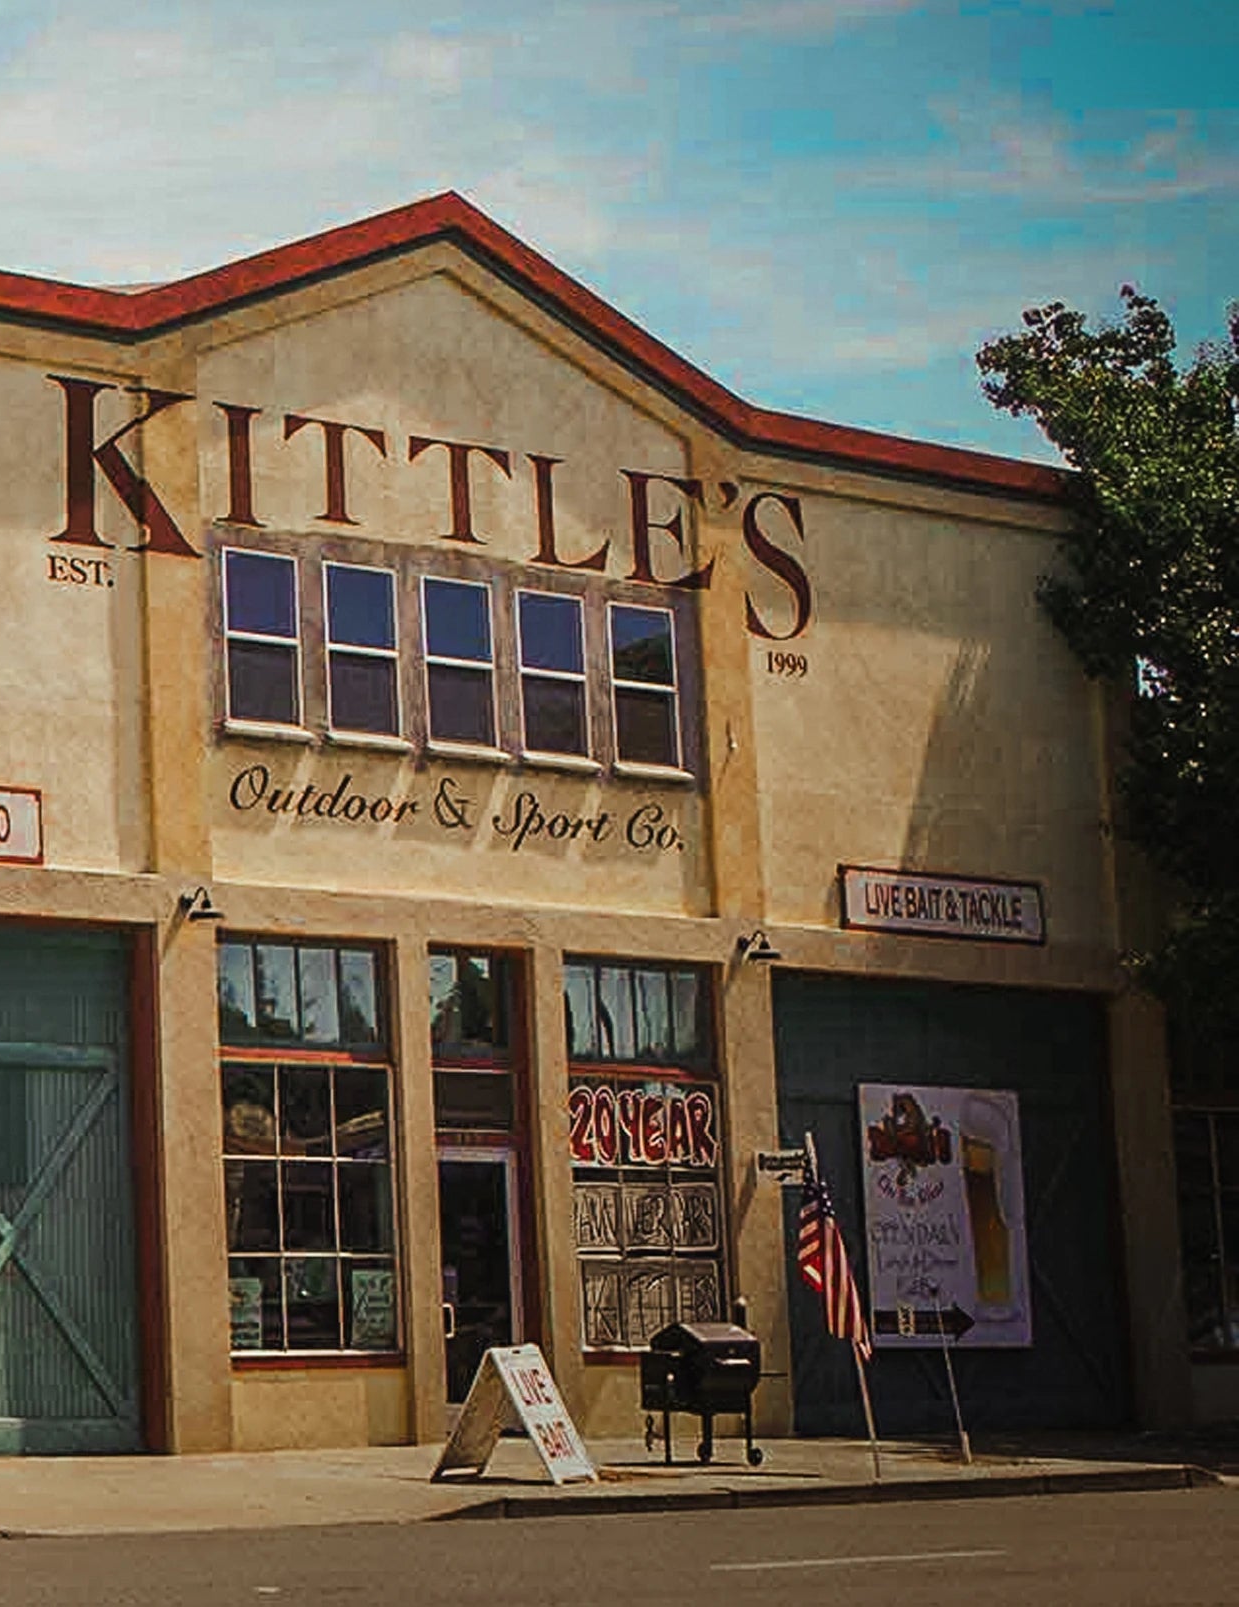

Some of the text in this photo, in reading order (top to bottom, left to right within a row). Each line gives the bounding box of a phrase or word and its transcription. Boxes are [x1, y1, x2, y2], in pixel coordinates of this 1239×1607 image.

[46, 373, 811, 641] KITTLE'S
[46, 555, 114, 588] EST.
[766, 650, 808, 678] 1999
[229, 764, 686, 853] Outdoor & Sport Co.
[864, 881, 1023, 929] LIVE BAIT & TACKLE
[568, 1086, 719, 1167] 20 YEAR
